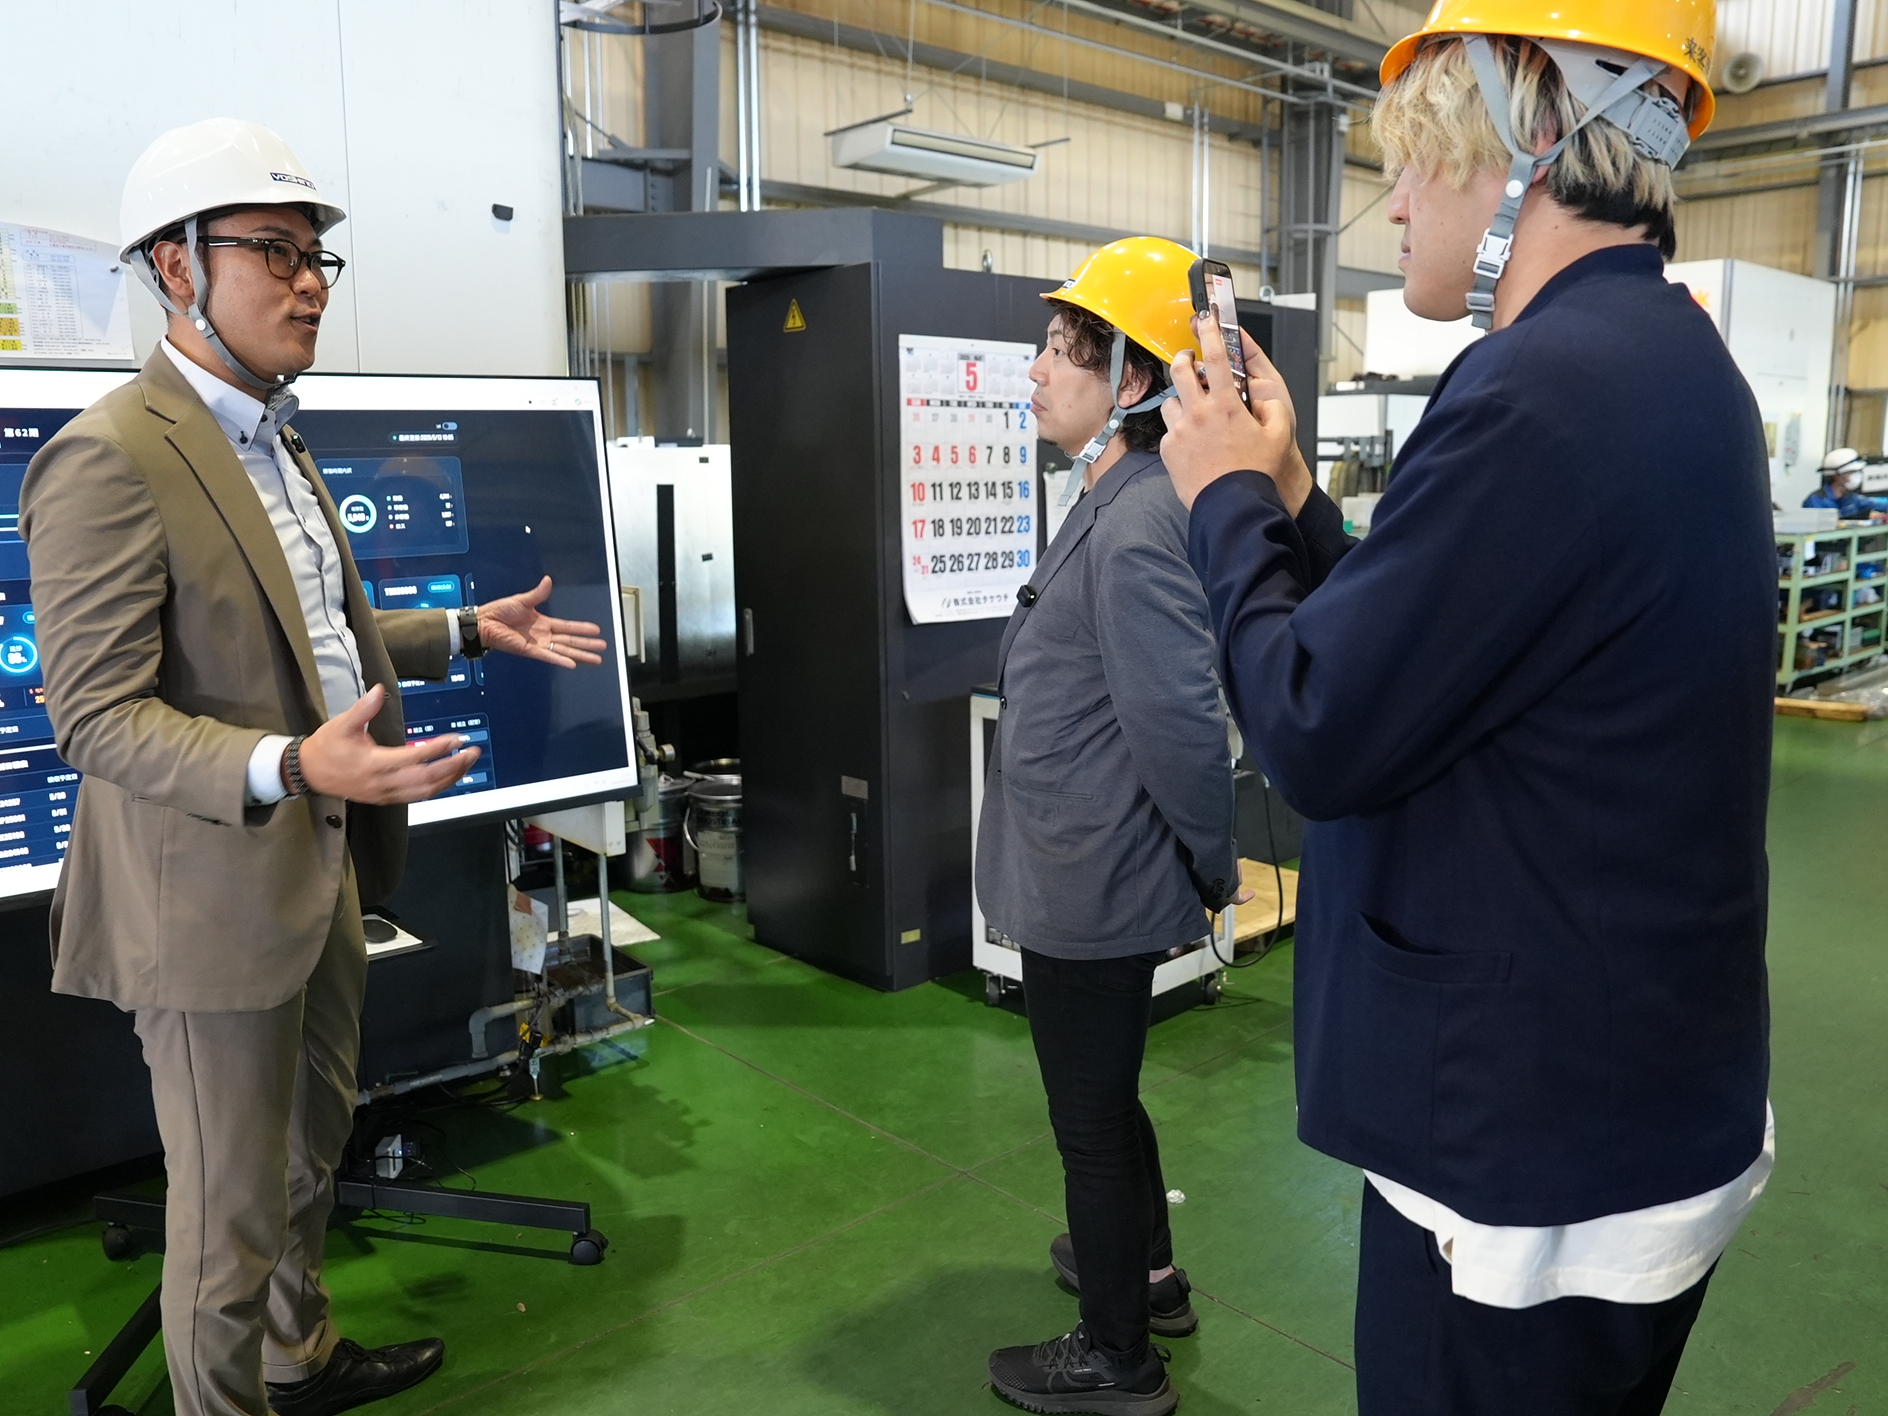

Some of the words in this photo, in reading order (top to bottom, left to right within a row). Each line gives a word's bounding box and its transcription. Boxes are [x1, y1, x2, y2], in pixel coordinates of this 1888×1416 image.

[966, 362, 978, 391] 5
[1003, 411, 1009, 430] 1
[1019, 411, 1027, 430] 2
[913, 445, 921, 465] 3
[932, 445, 941, 465] 4
[951, 445, 959, 464] 5
[969, 445, 977, 464] 6
[986, 446, 993, 464] 7
[1003, 446, 1010, 464] 8
[1019, 446, 1027, 464] 9
[911, 482, 926, 502] 10
[931, 482, 943, 501] 11
[949, 482, 962, 501] 12
[967, 481, 980, 500] 13
[984, 481, 997, 500] 14
[1001, 481, 1014, 499] 15
[1018, 480, 1030, 499] 16
[912, 518, 927, 539] 17
[931, 518, 945, 538] 18
[949, 518, 963, 537] 19
[966, 517, 981, 536] 20
[984, 516, 998, 535] 21
[1001, 516, 1015, 534] 22
[1017, 515, 1031, 533] 23
[931, 555, 946, 574] 25
[949, 554, 964, 573] 26
[966, 553, 981, 572] 27
[984, 552, 998, 570] 28
[1001, 551, 1015, 569] 29
[1017, 549, 1030, 568] 30
